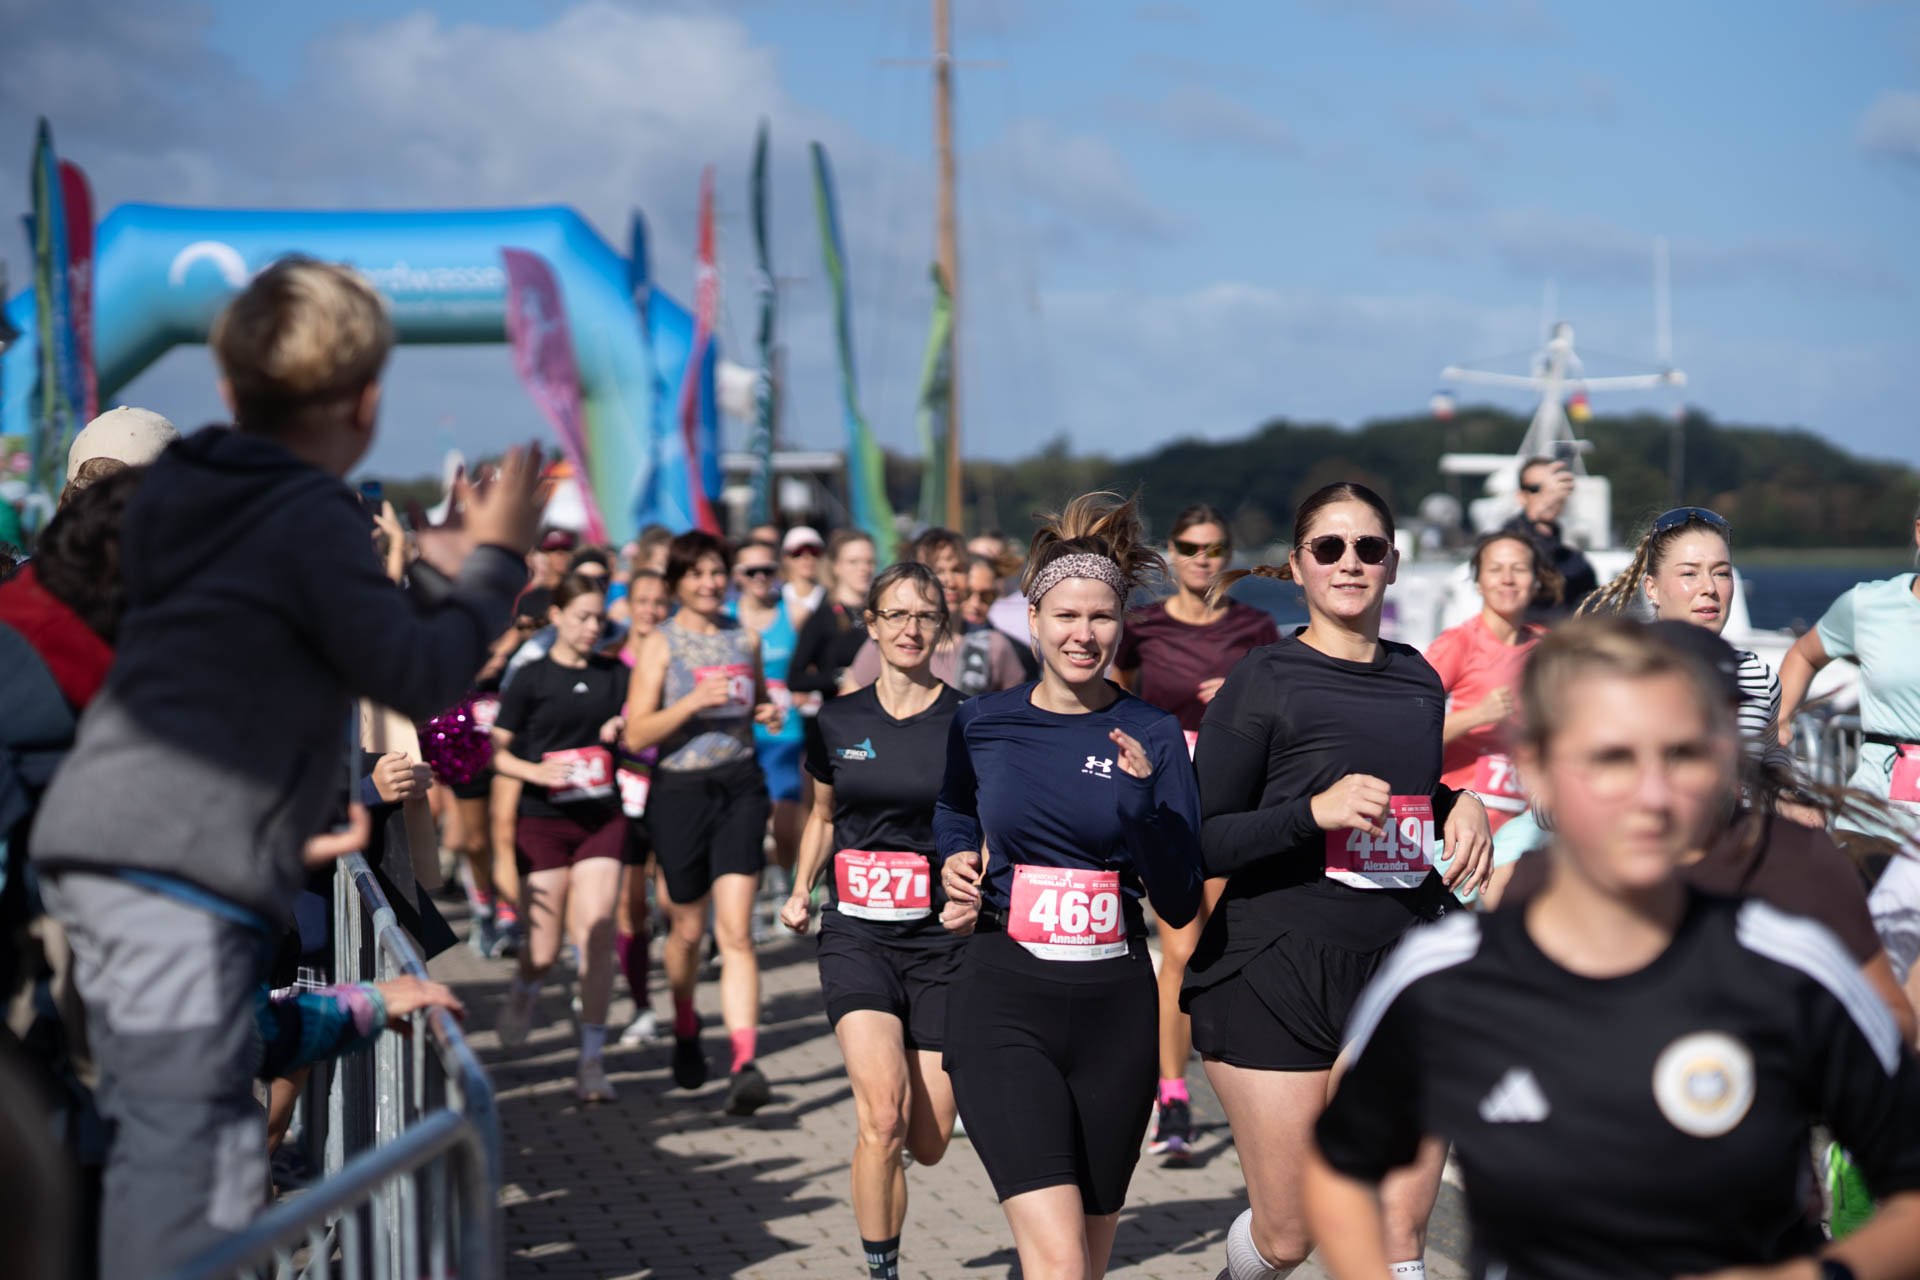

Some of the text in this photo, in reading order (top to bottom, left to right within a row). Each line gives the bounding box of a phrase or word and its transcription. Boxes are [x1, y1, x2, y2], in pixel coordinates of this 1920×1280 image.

[1346, 817, 1421, 859] 449
[848, 865, 913, 900] 527
[1363, 861, 1409, 871] Alexandra
[1029, 889, 1118, 934] 469
[1049, 933, 1096, 945] Annabell
